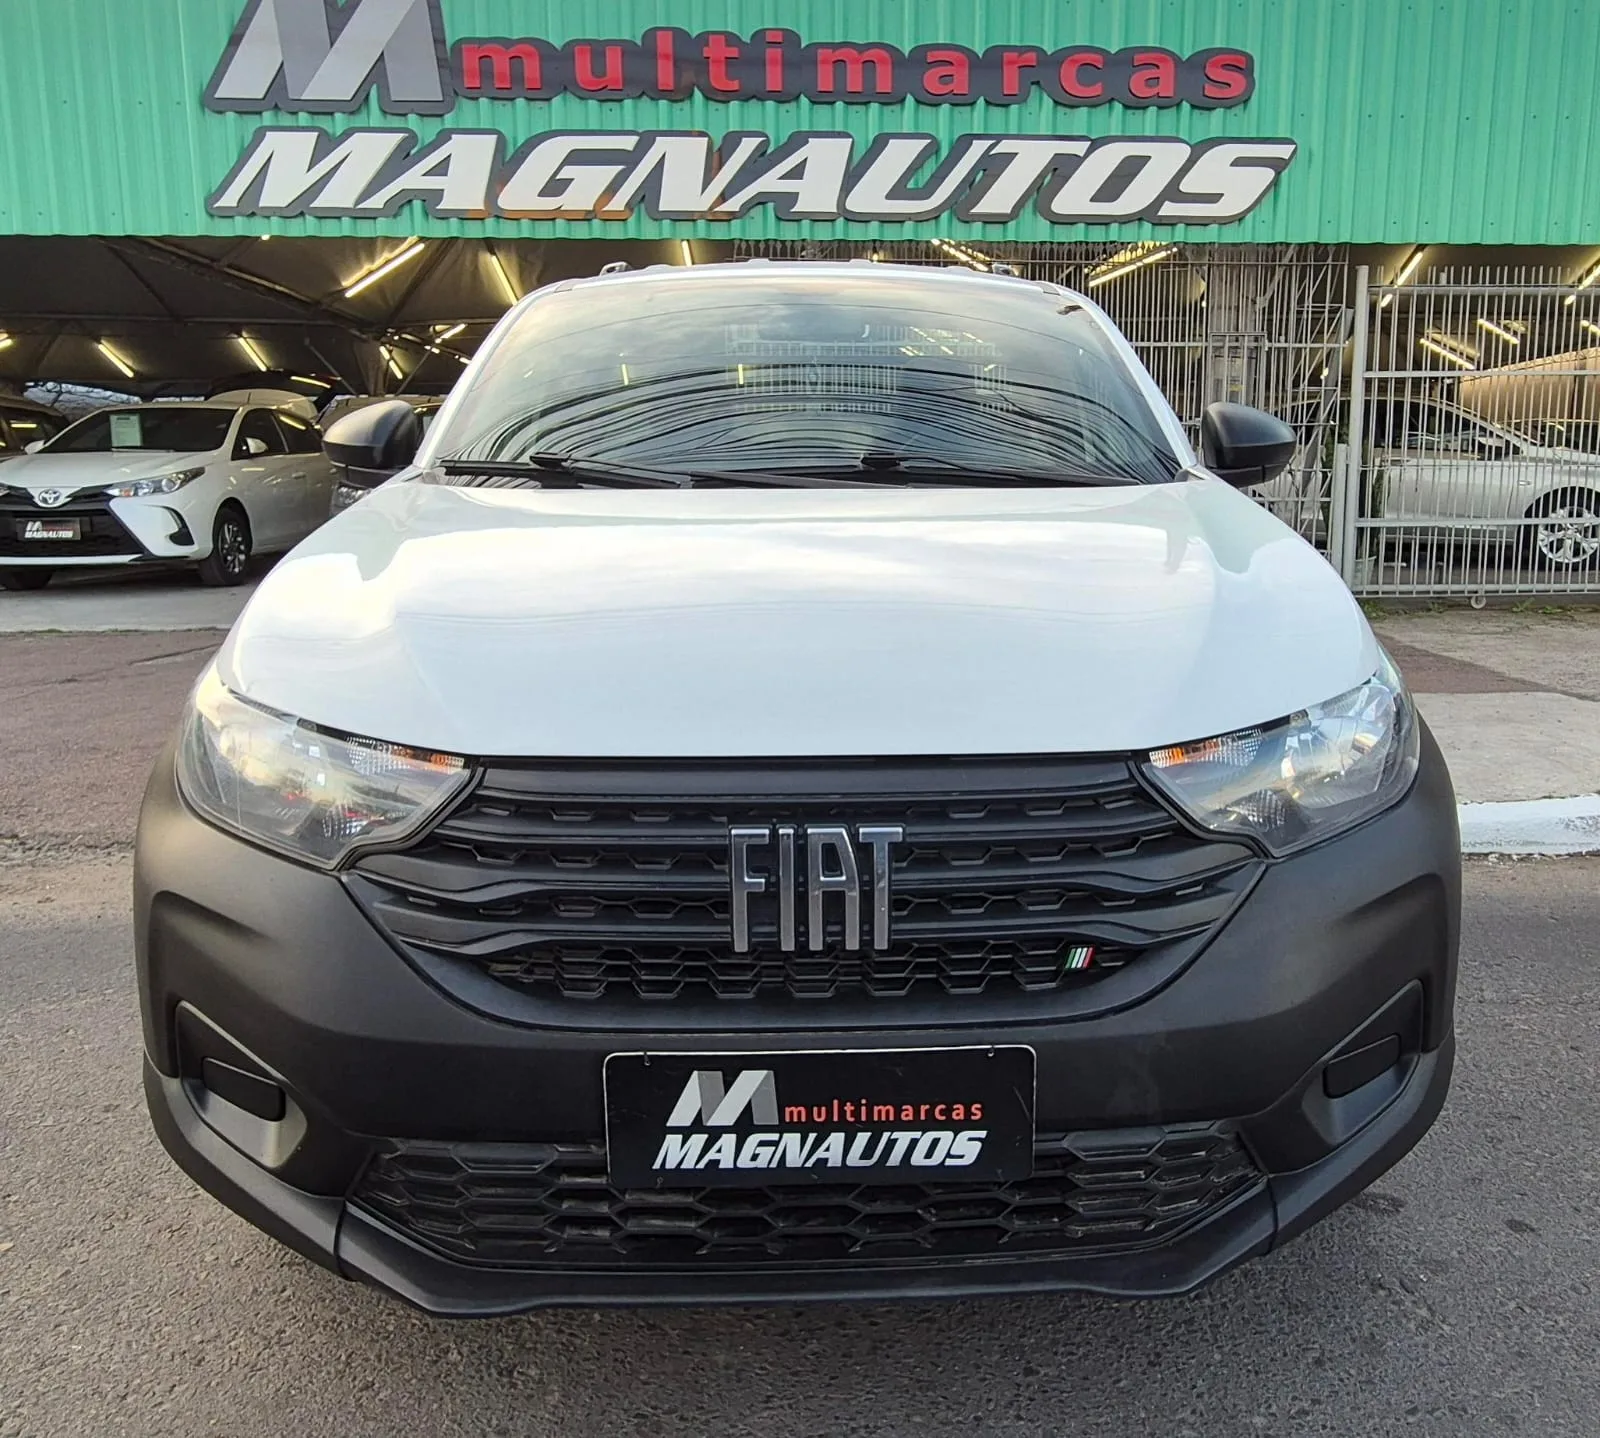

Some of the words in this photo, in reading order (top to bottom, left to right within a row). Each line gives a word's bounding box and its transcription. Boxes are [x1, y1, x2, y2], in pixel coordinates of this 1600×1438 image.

[462, 29, 1249, 99] multimarcas
[212, 131, 1297, 217] MAGNAUTOS
[730, 827, 904, 952] FIAT
[784, 1099, 984, 1122] multimarcas
[652, 1130, 988, 1169] MAGNAUTOS
